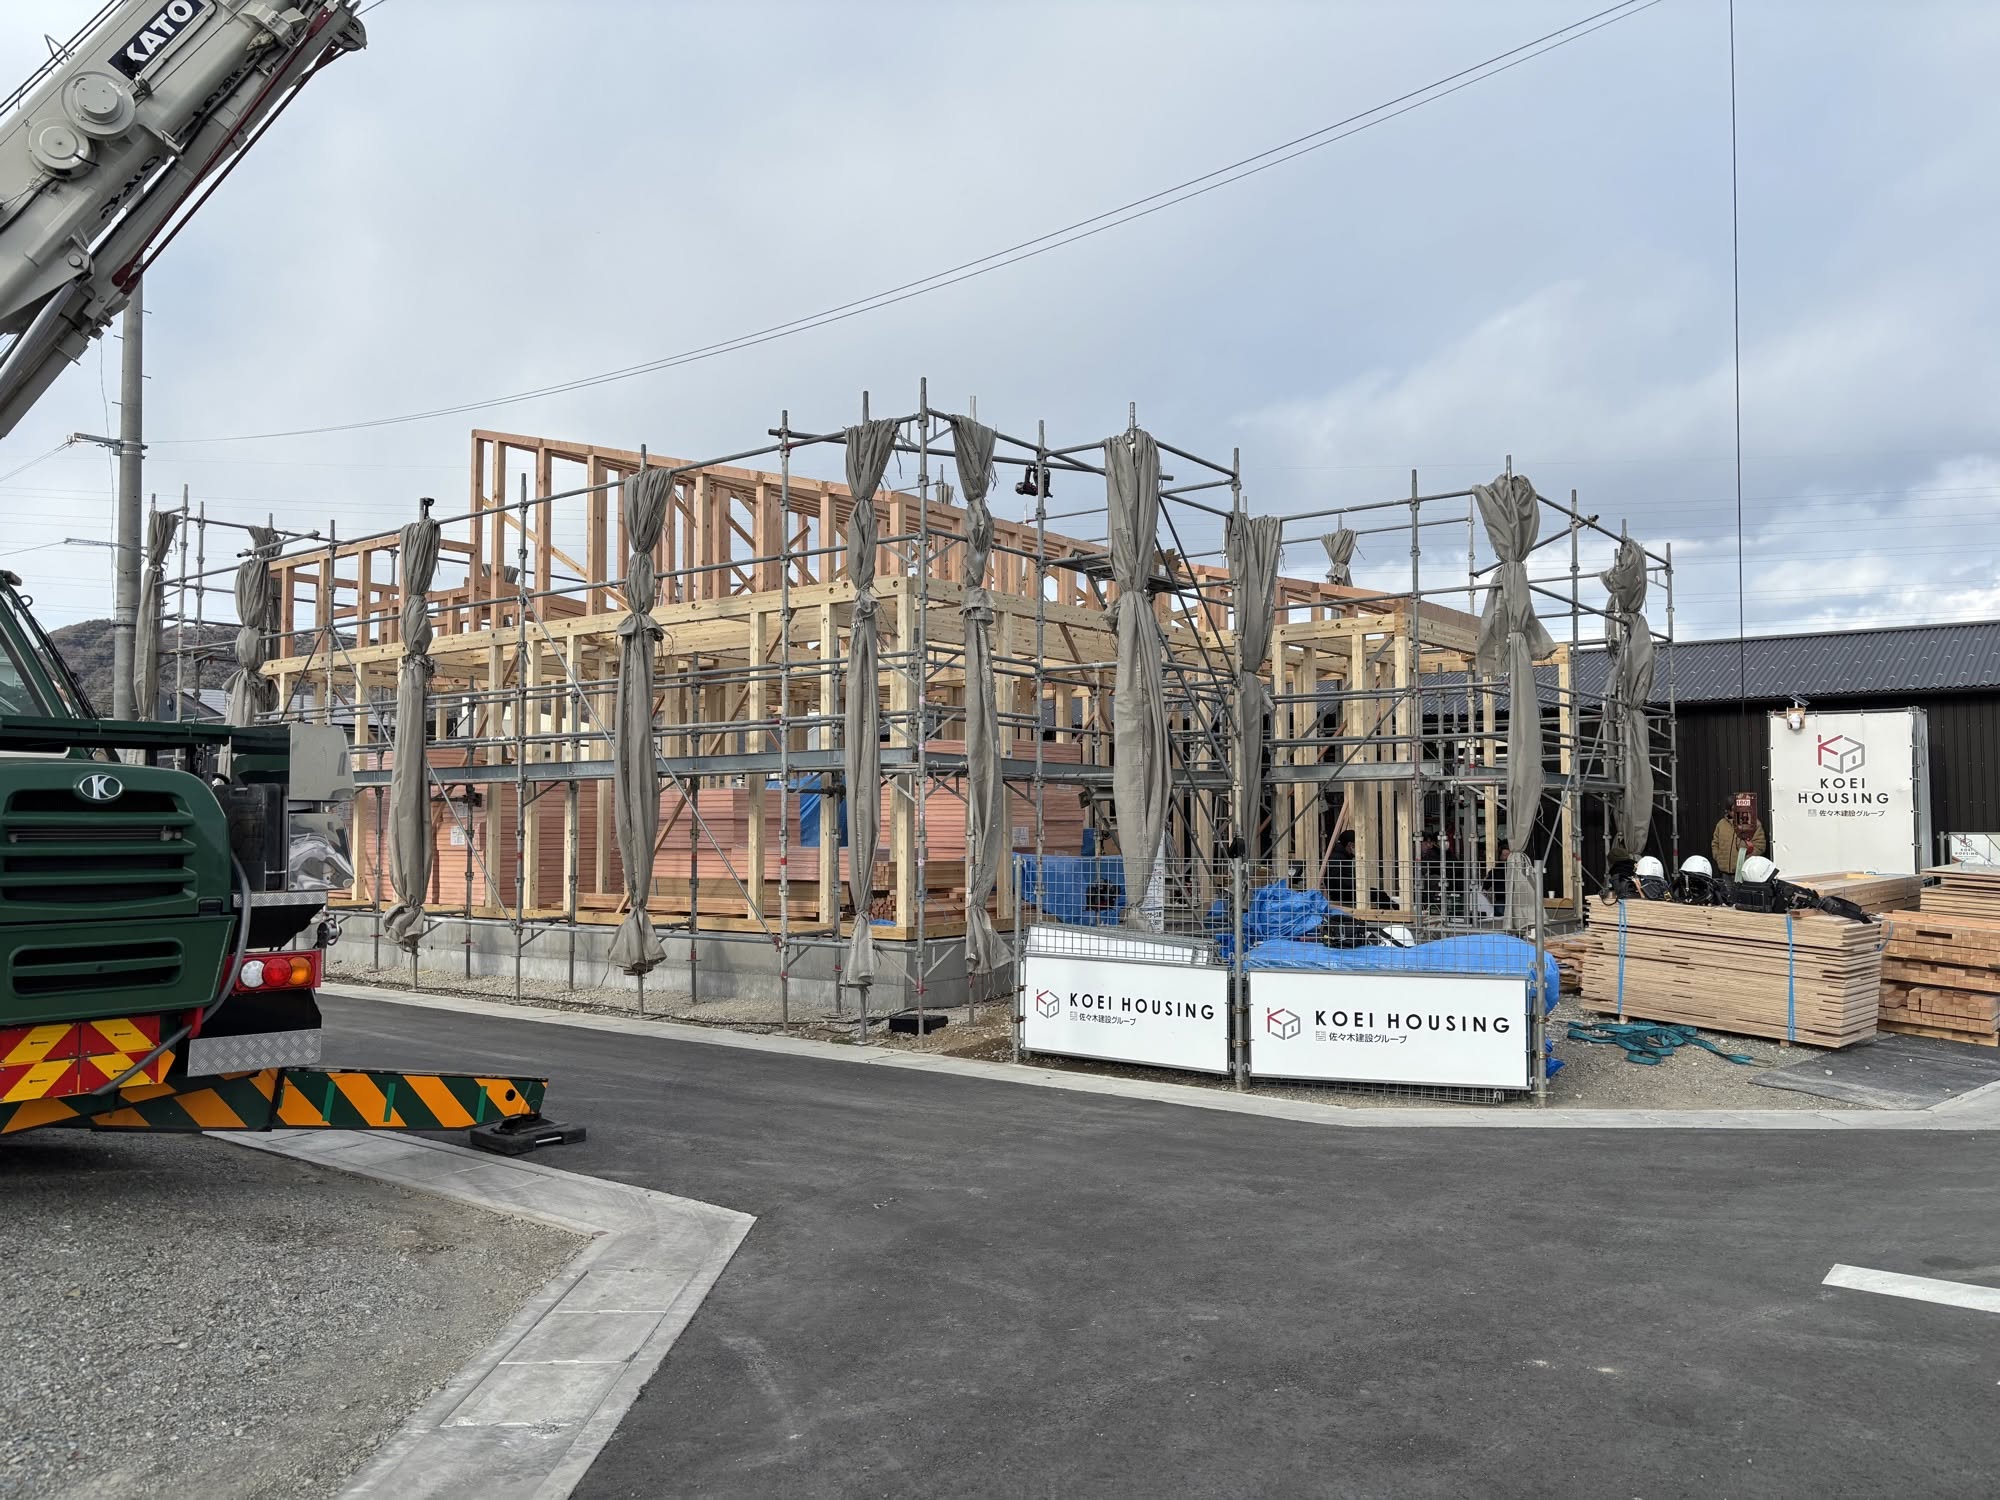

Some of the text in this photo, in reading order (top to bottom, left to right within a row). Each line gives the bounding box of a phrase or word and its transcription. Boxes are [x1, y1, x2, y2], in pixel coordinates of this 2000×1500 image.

[126, 0, 194, 62] KATO
[1820, 777, 1865, 789] KOEI
[1798, 792, 1889, 804] HOUSING
[1819, 809, 1886, 817] 佐々木建設グループ
[1069, 992, 1215, 1020] KOEI HOUSING
[1079, 1012, 1137, 1026] 佐々木建設グループ
[1315, 1010, 1510, 1033] KOEI HOUSING
[1328, 1031, 1408, 1044] 佐々木建設グループ
